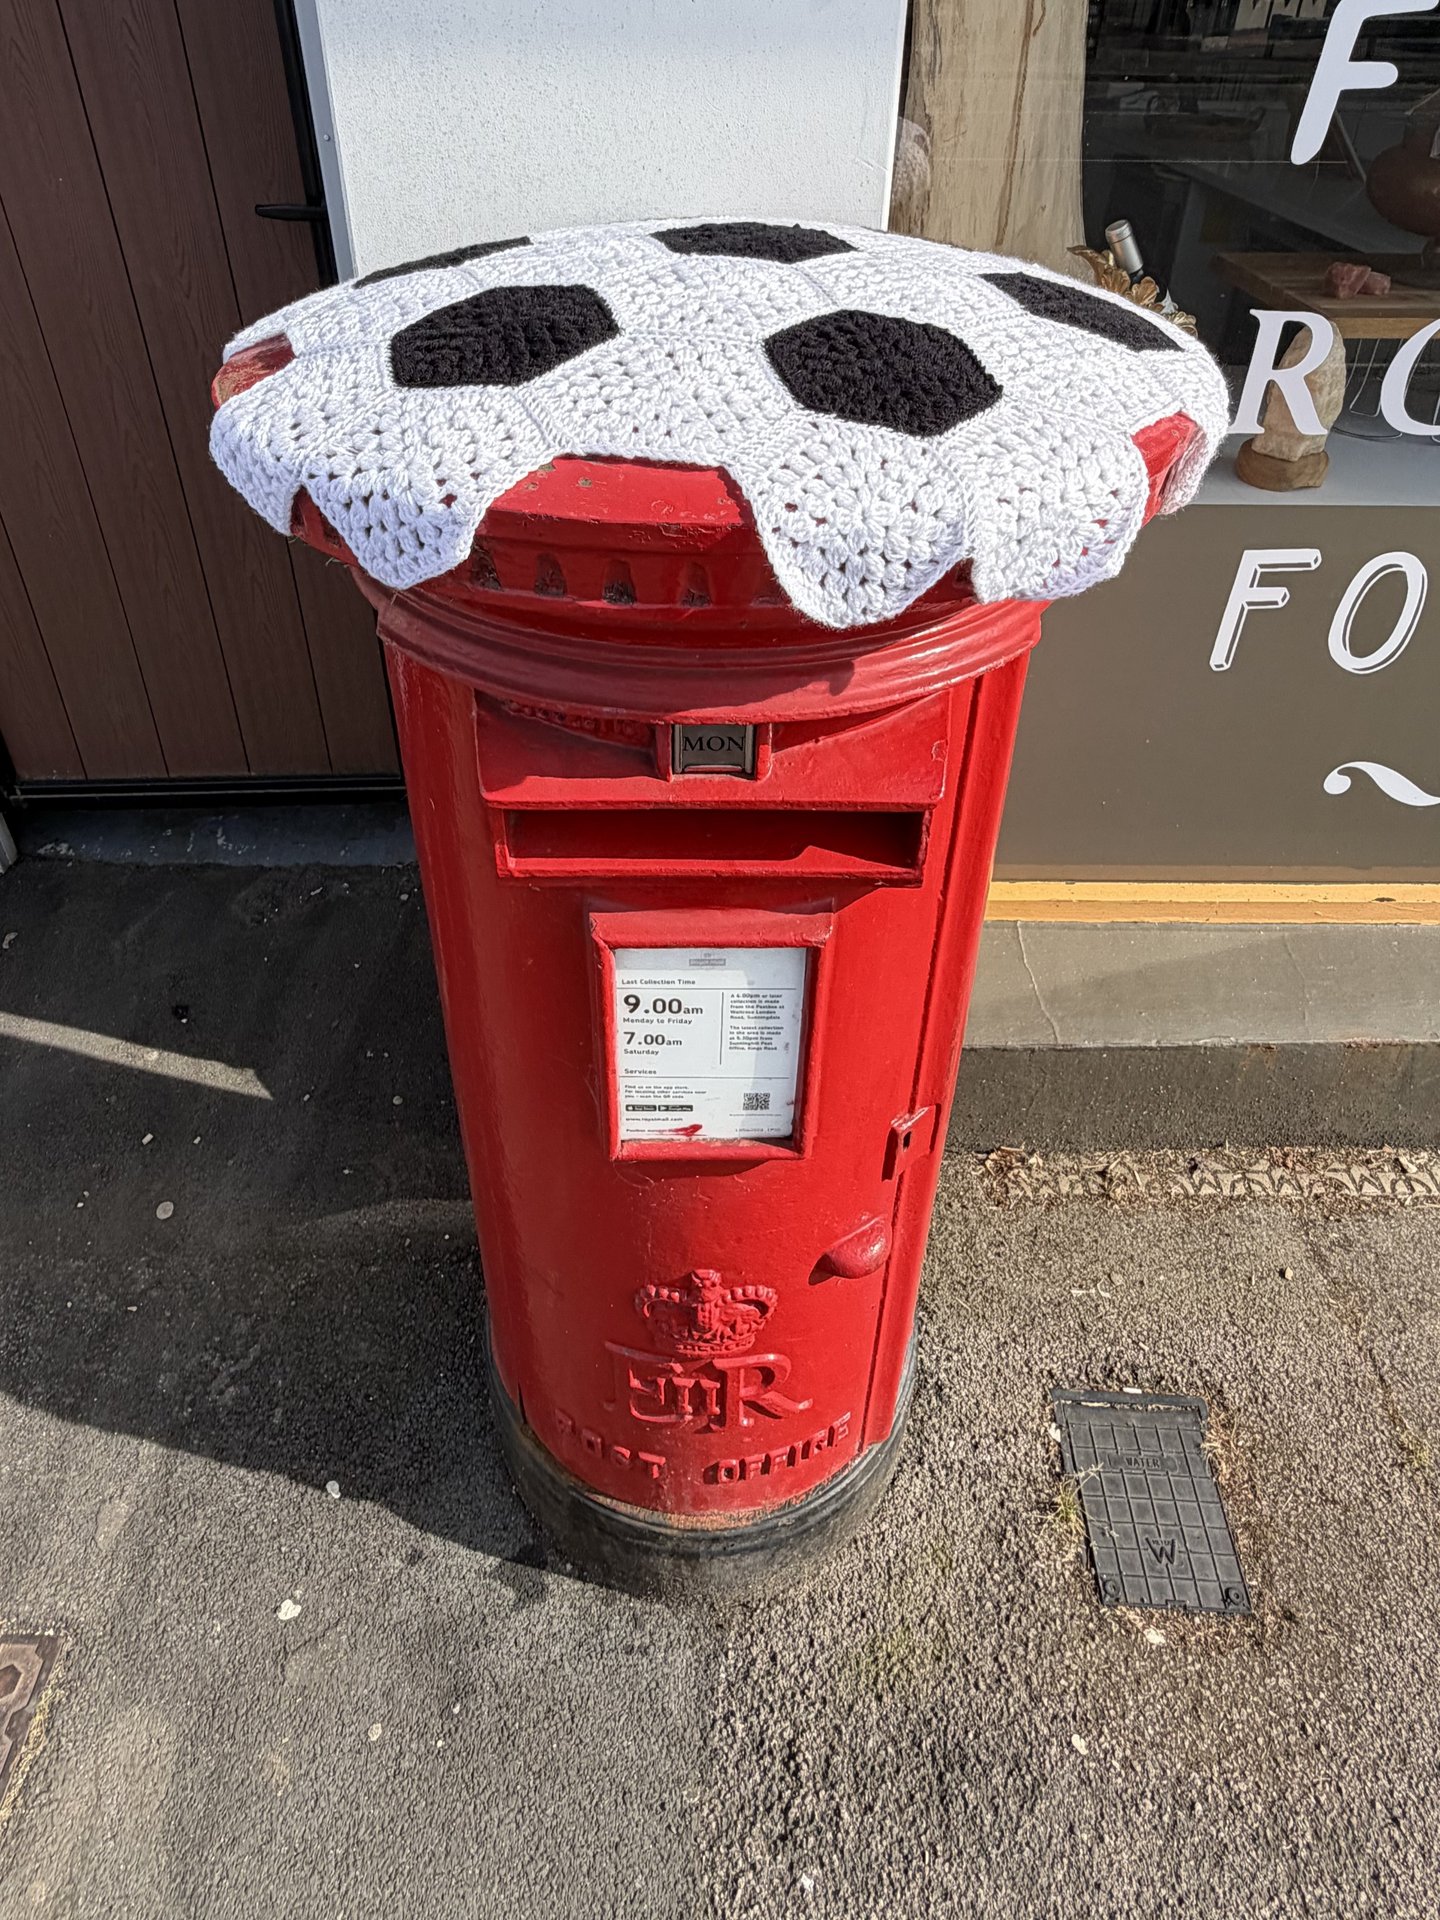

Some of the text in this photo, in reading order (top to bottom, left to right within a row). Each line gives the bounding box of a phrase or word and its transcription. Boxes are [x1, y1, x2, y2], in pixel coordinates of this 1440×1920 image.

[1209, 548, 1428, 674] FO
[683, 735, 745, 752] MON
[623, 994, 703, 1015] 9.00am
[623, 1017, 655, 1025] Monday
[623, 1031, 682, 1046] 7.00am
[624, 1048, 659, 1056] Saturday
